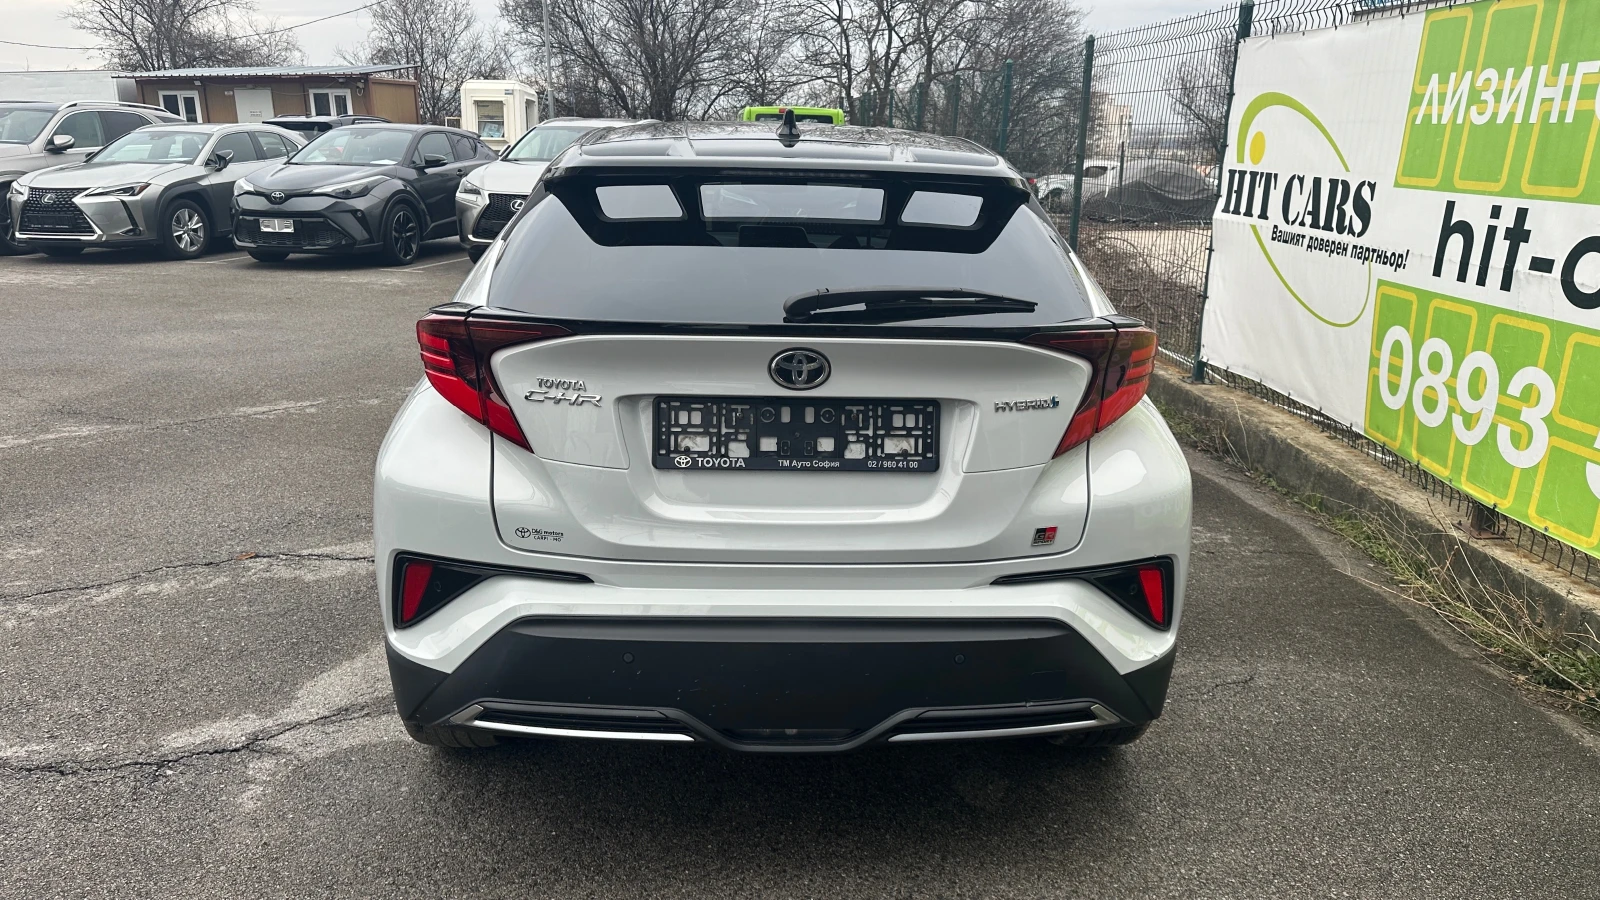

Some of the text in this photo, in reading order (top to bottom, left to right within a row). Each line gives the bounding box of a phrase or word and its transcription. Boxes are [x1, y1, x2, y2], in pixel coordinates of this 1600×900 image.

[1415, 60, 1600, 125] ЛИЗИНГ
[1221, 168, 1377, 238] HIT CARS
[1271, 224, 1410, 272] Вашият доверен партньор!
[536, 377, 587, 392] TOYOTA
[524, 389, 602, 407] C-HR
[1379, 325, 1556, 469] 0893
[994, 398, 1050, 413] HYBRID
[696, 457, 746, 468] TOYOTA
[791, 460, 811, 469] Ауто
[812, 459, 840, 469] София
[867, 460, 877, 468] 02
[897, 460, 908, 468] 41
[908, 460, 919, 468] 00
